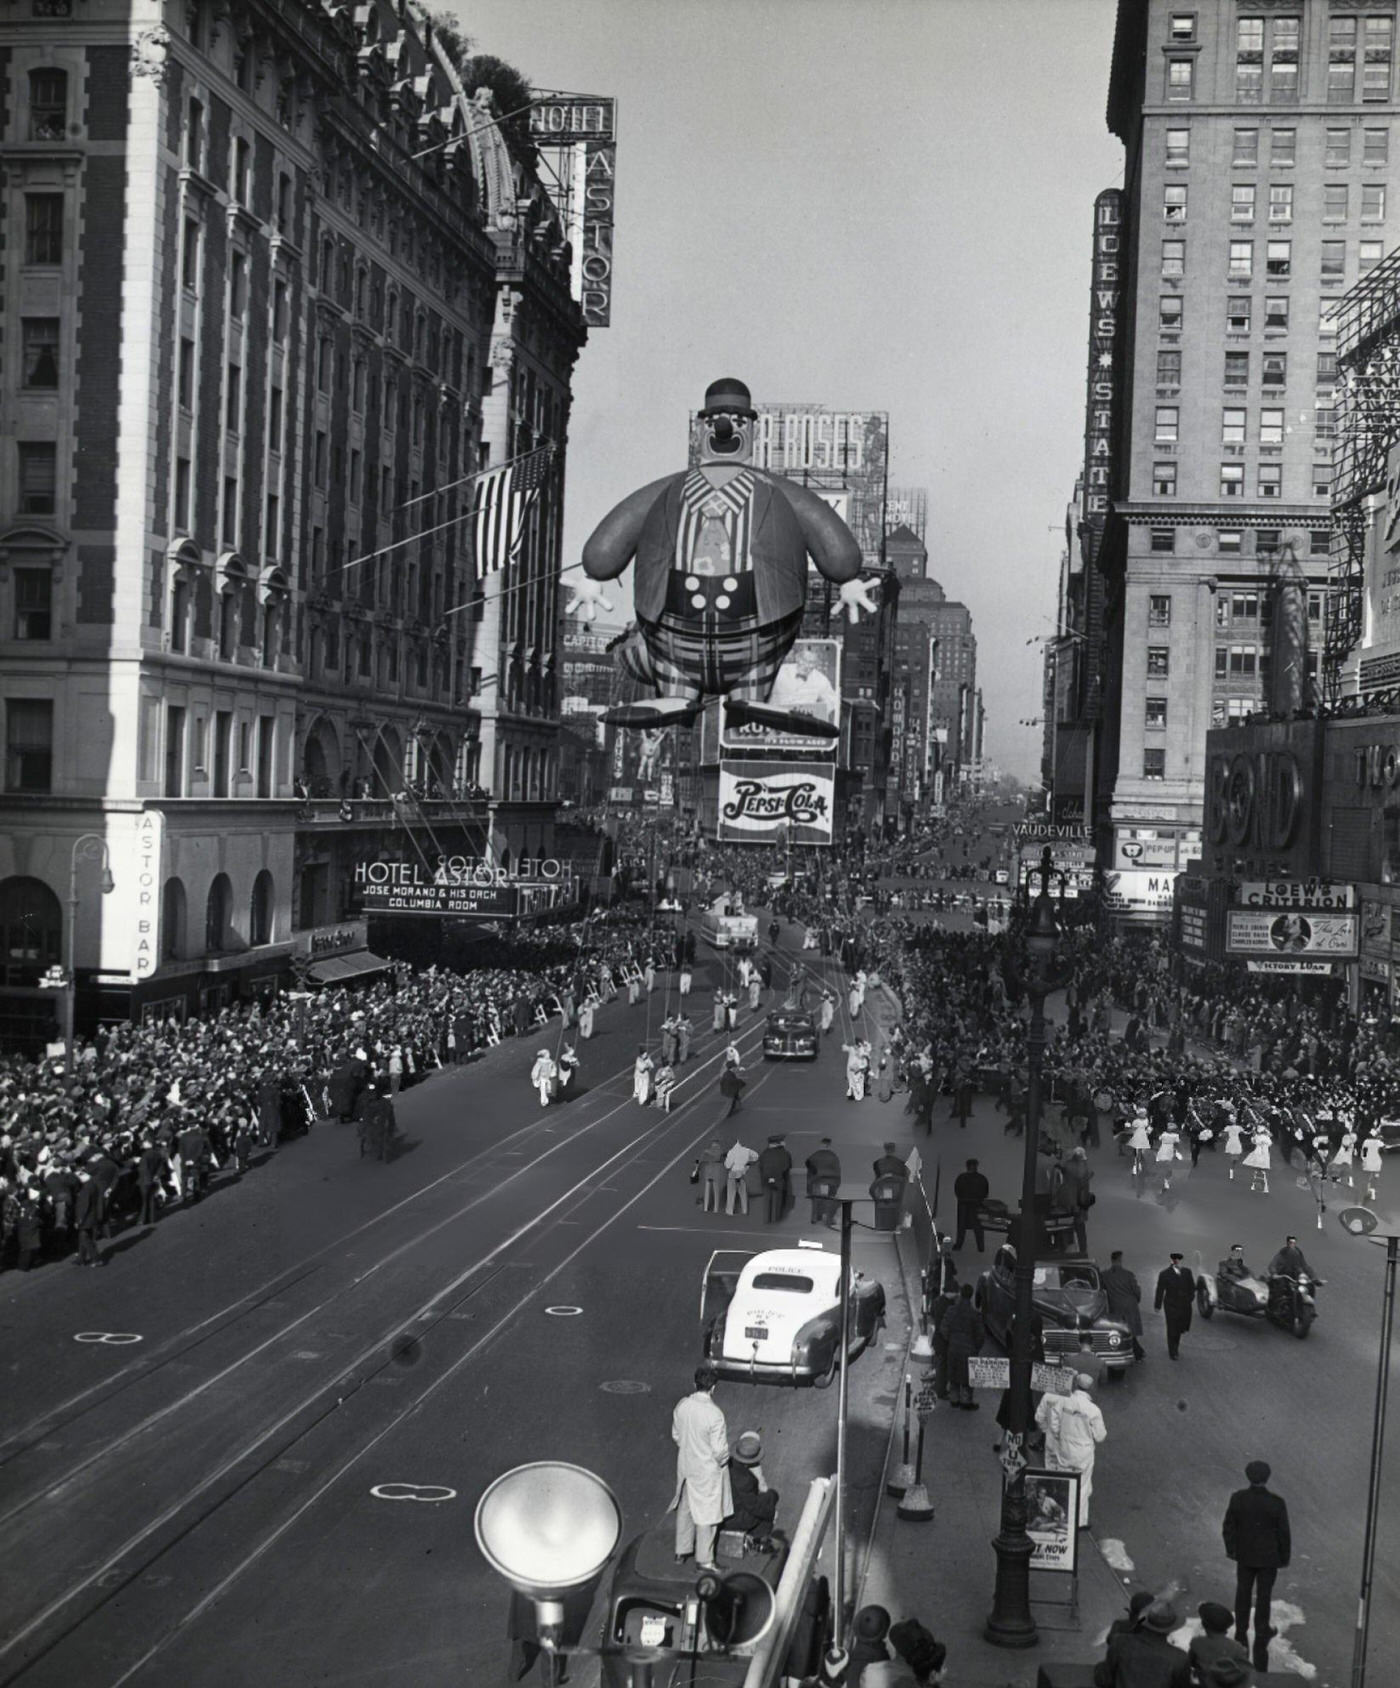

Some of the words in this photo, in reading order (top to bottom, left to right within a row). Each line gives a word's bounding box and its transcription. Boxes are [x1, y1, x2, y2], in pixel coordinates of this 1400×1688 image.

[582, 151, 612, 316] ASTOR
[784, 413, 863, 468] ROSES
[1088, 382, 1112, 512] STATE
[890, 687, 904, 761] HOWARD
[1210, 752, 1303, 849] BOND
[1012, 823, 1092, 839] VAUDEVILLE
[139, 817, 153, 905] ASTOR
[355, 861, 424, 885] HOTEL
[434, 865, 509, 888] ASTOR
[363, 885, 389, 896] JOSE
[393, 886, 436, 898] MORAND
[438, 886, 446, 898] &
[450, 887, 466, 898] HIS
[469, 888, 497, 900] ORCH
[1265, 882, 1331, 897] LOEW'S
[389, 897, 442, 909] COLUMBIA
[448, 899, 478, 910] ROOM
[1248, 893, 1347, 909] CRITERION
[137, 920, 150, 971] BAR
[1300, 961, 1326, 972] LOAN
[1008, 1433, 1021, 1445] NO
[1009, 1450, 1018, 1460] U
[1045, 1543, 1068, 1555] NOW
